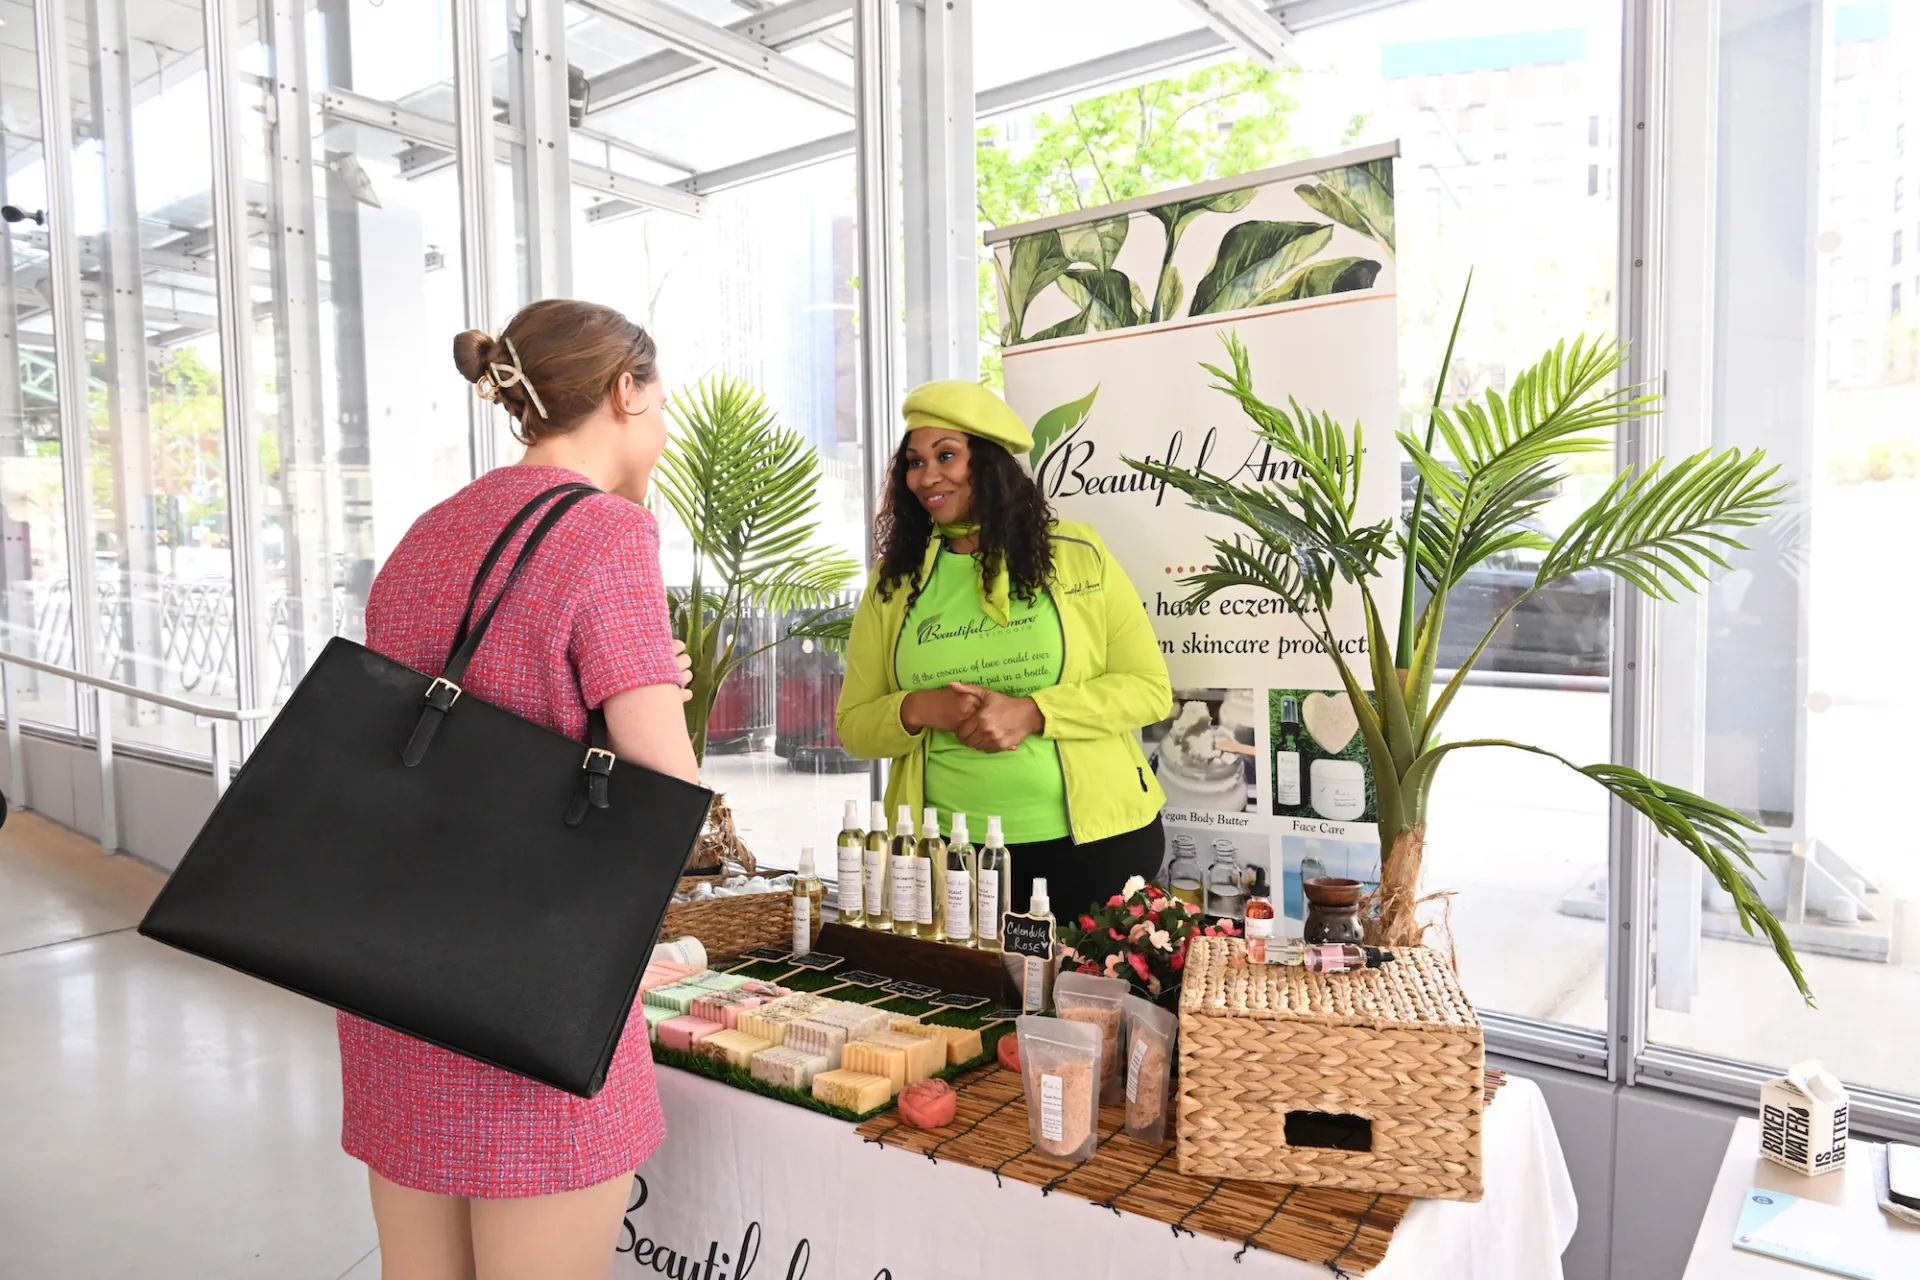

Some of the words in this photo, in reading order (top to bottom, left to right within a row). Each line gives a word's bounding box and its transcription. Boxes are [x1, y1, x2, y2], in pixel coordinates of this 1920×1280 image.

[918, 615, 988, 645] Beautiful
[1181, 632, 1270, 654] skincare
[921, 671, 934, 681] the
[936, 666, 968, 678] essence
[971, 659, 979, 673] of
[981, 658, 1000, 669] love
[1003, 651, 1028, 665] could
[1031, 652, 1050, 661] ever
[1003, 672, 1012, 681] in
[1189, 811, 1214, 826] Body
[1217, 813, 1249, 827] Butter
[1292, 820, 1317, 832] Face
[1319, 822, 1345, 835] Care
[1762, 1104, 1785, 1156] BOXED
[1784, 1112, 1810, 1165] WATER
[1815, 1151, 1831, 1168] IS
